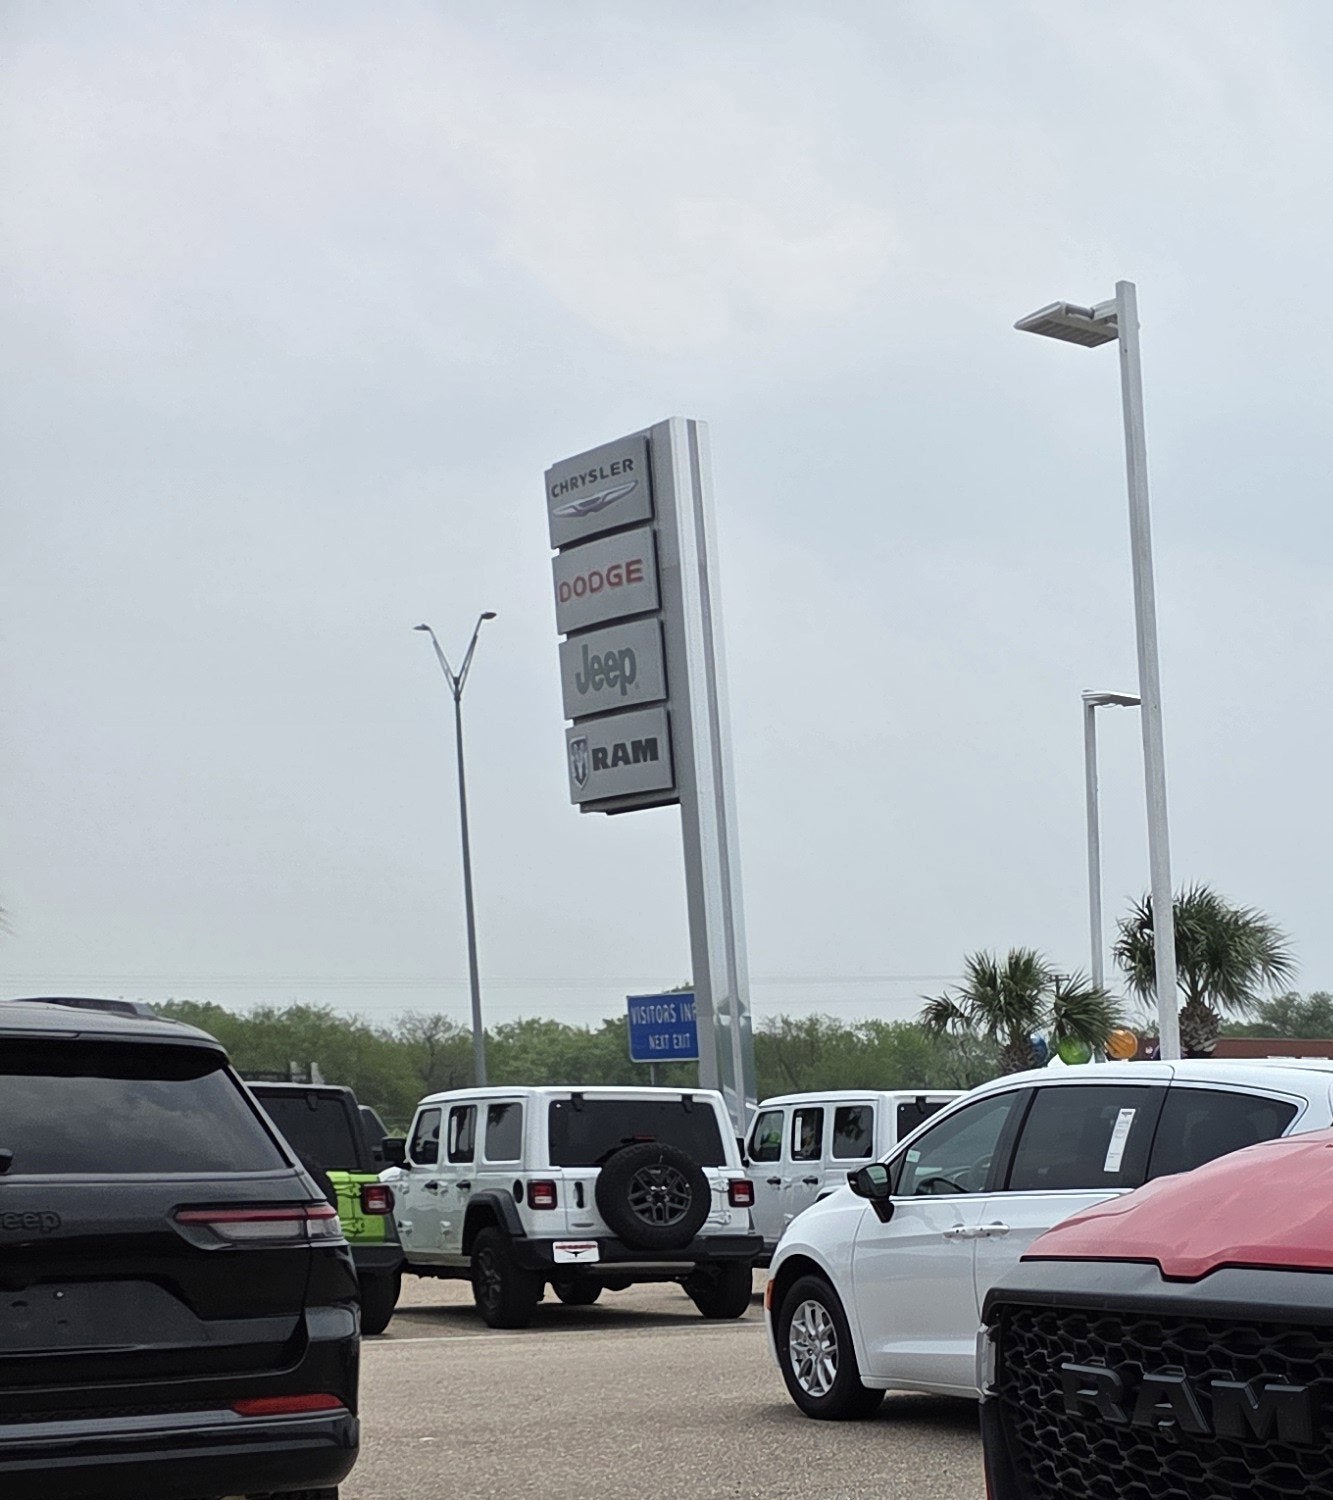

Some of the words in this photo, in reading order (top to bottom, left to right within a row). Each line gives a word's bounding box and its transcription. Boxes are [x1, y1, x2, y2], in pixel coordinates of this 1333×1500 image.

[551, 458, 634, 498] CHRYSLER
[558, 558, 644, 603] DODGE
[575, 644, 637, 696] Jeep
[591, 737, 659, 771] RAM
[631, 1004, 677, 1025] VISITORS
[648, 1034, 669, 1050] NEXT
[672, 1033, 690, 1049] EXIT
[0, 1211, 61, 1233] eep
[1060, 1362, 1313, 1445] RAM
